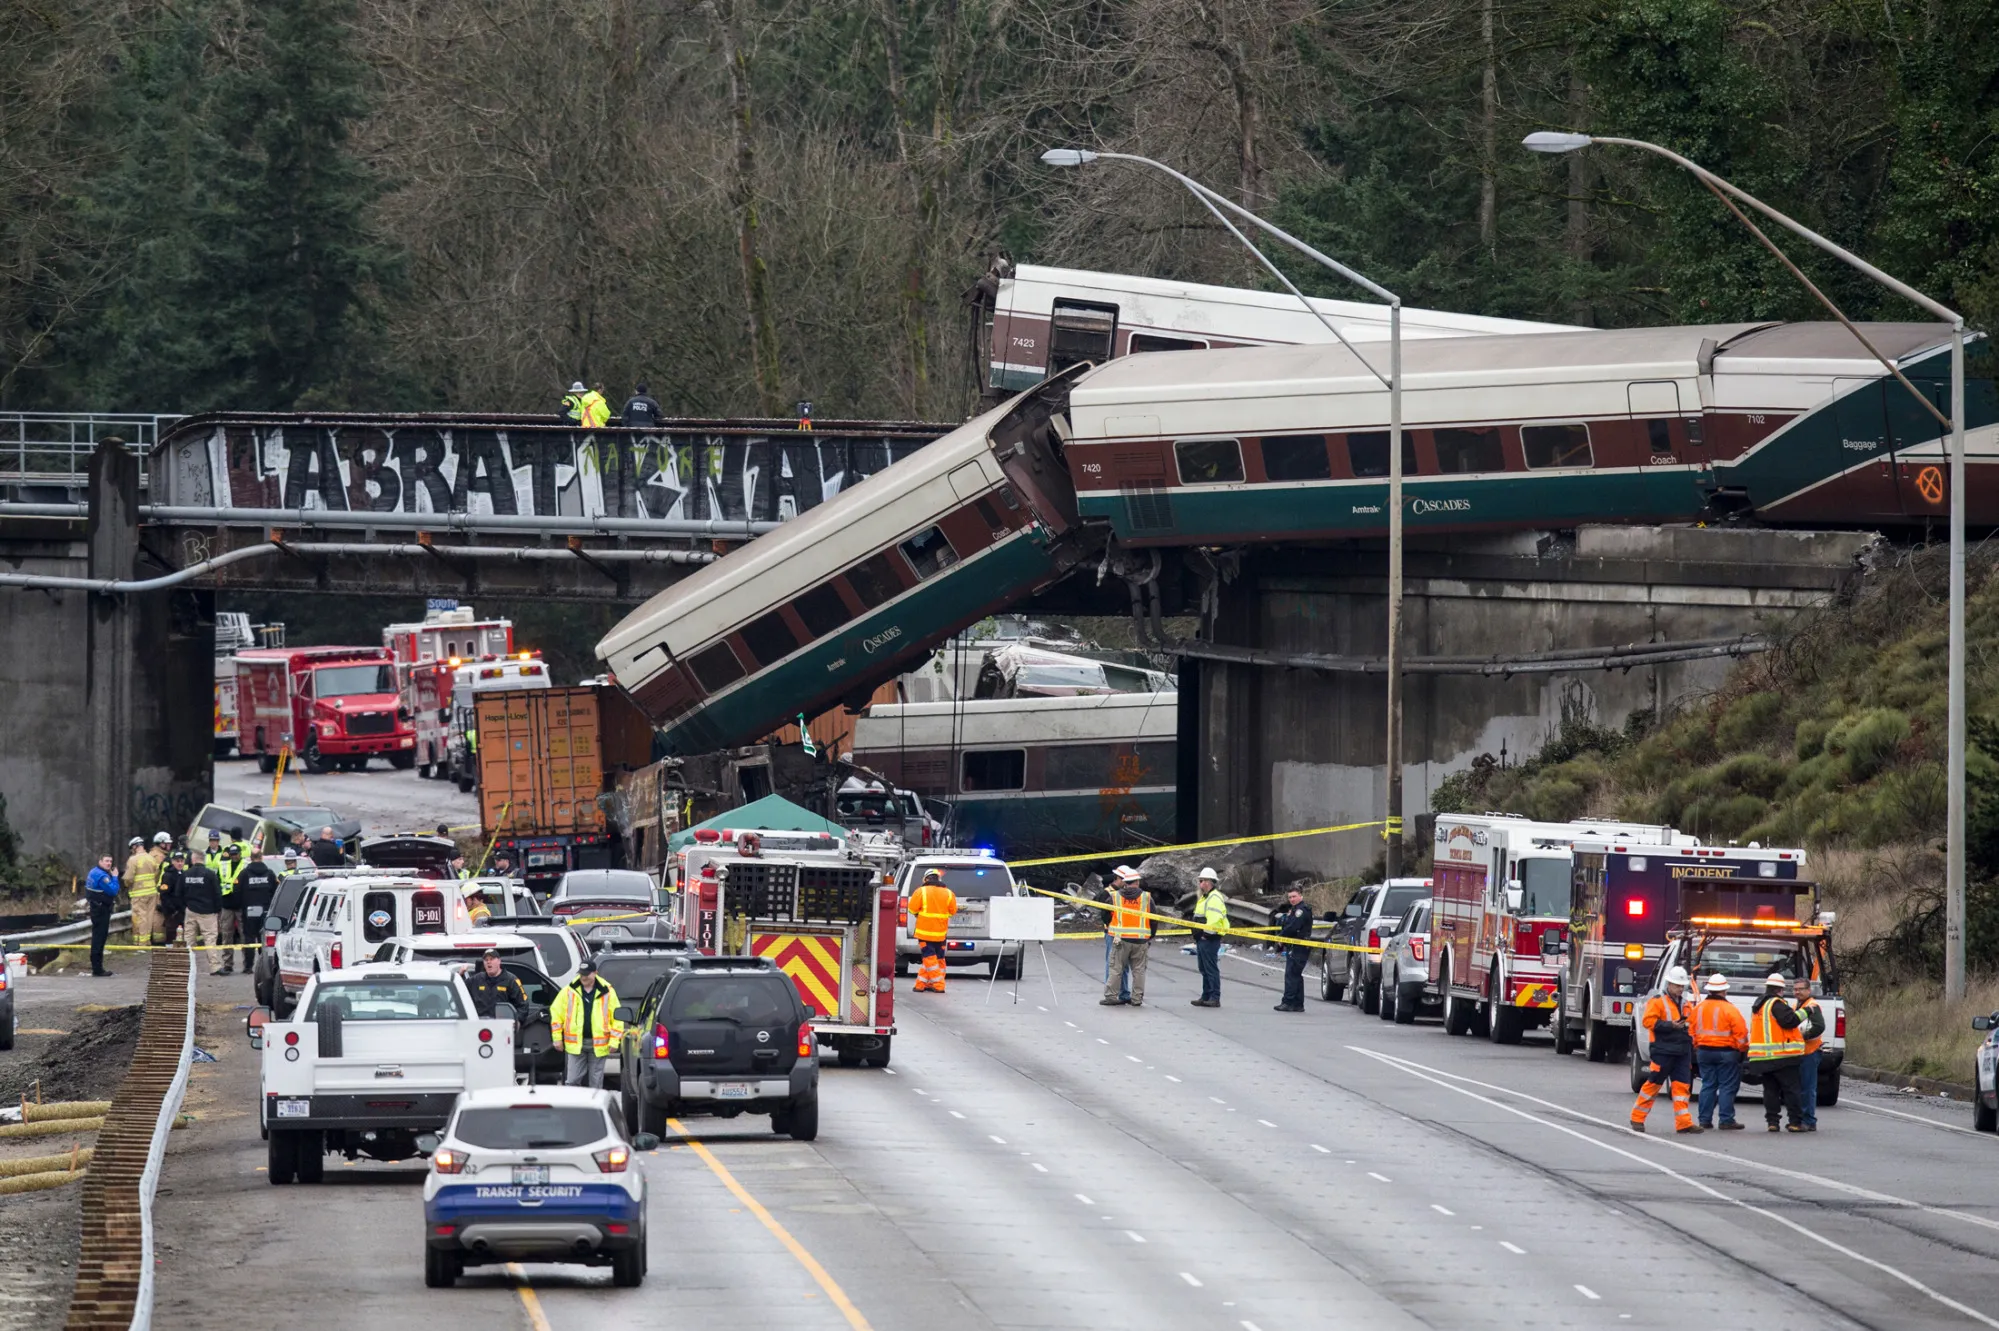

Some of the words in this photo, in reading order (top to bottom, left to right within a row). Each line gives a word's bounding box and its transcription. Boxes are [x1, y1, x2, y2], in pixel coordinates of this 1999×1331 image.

[1012, 337, 1035, 348] 7423
[1747, 414, 1765, 424] 7102
[1843, 439, 1877, 450] Baggage
[1650, 455, 1677, 465] Coach
[1082, 464, 1102, 473] 7420
[1352, 505, 1379, 514] Amtrak
[991, 526, 1012, 541] Coach
[826, 657, 847, 672] Amtrak
[1120, 813, 1148, 822] Amtrak
[1671, 867, 1733, 879] INCIDENT
[418, 910, 439, 921] B-101
[704, 911, 713, 920] E
[702, 923, 712, 948] 101
[475, 1186, 524, 1198] TRANSIT
[528, 1186, 583, 1197] SECURITY
